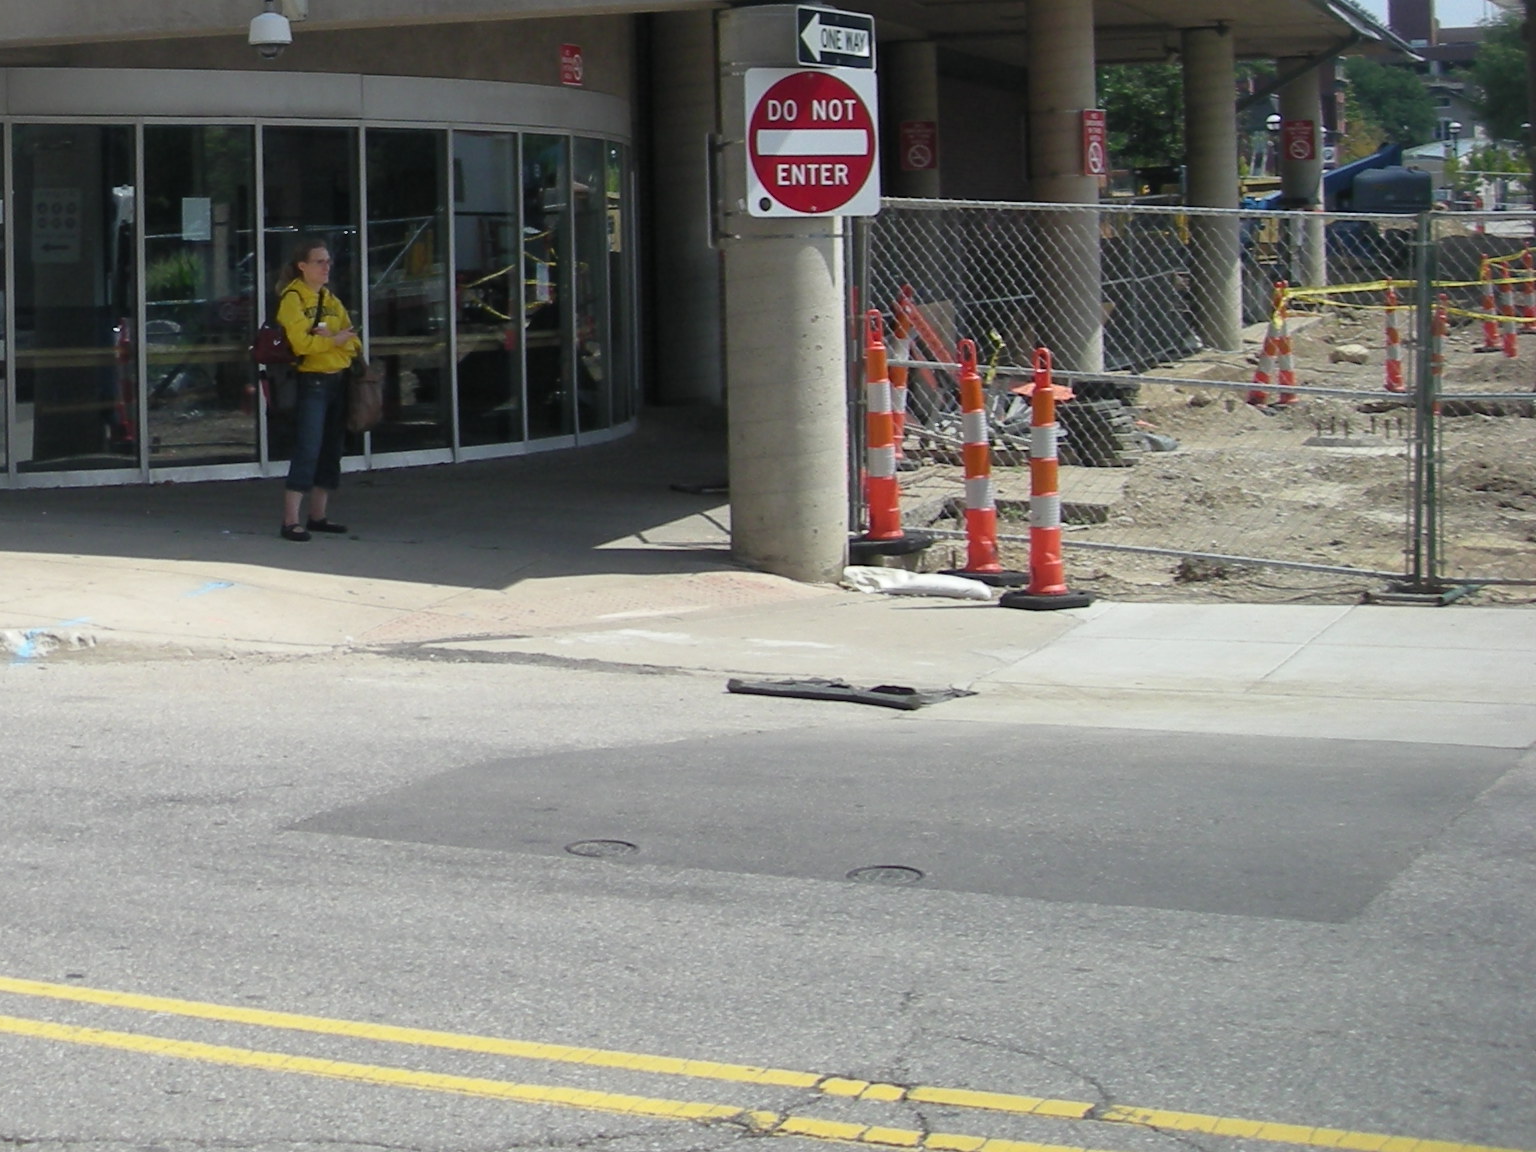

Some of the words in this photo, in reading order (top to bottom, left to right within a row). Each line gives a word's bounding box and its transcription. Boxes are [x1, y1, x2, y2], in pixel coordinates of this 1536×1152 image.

[820, 28, 842, 50] ONE
[845, 31, 867, 53] WAY
[767, 100, 798, 122] DO
[812, 100, 857, 121] NOT
[776, 164, 849, 186] ENTER
